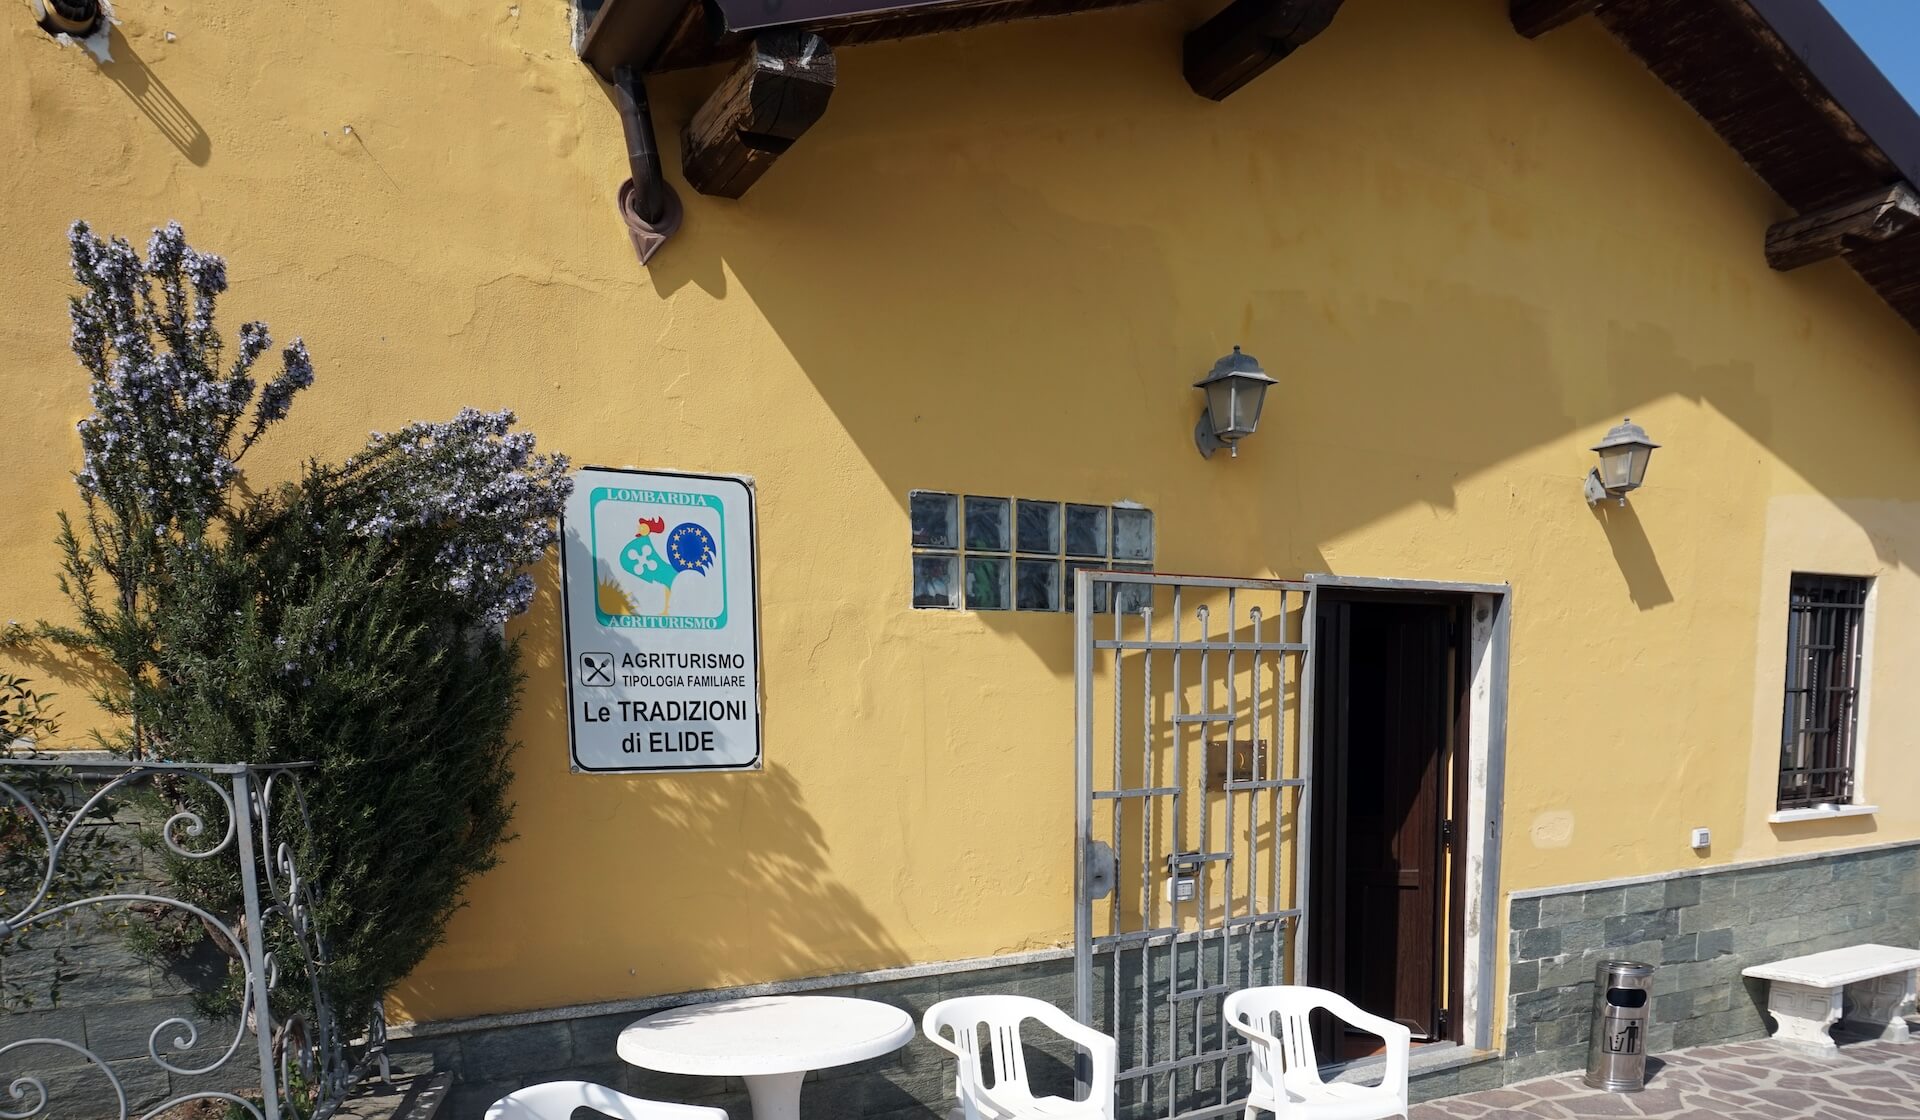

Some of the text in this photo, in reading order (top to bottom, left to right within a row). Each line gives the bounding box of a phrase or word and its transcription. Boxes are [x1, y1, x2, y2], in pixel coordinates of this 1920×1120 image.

[606, 488, 707, 506] LOMBARDIA
[608, 616, 718, 629] AGRITURISMO
[622, 653, 745, 669] AGRITURISMO
[622, 675, 746, 688] TIPOLOGIA FAMILIARE
[584, 700, 747, 722] Le TRADIZIONI
[622, 731, 714, 753] di ELIDE
